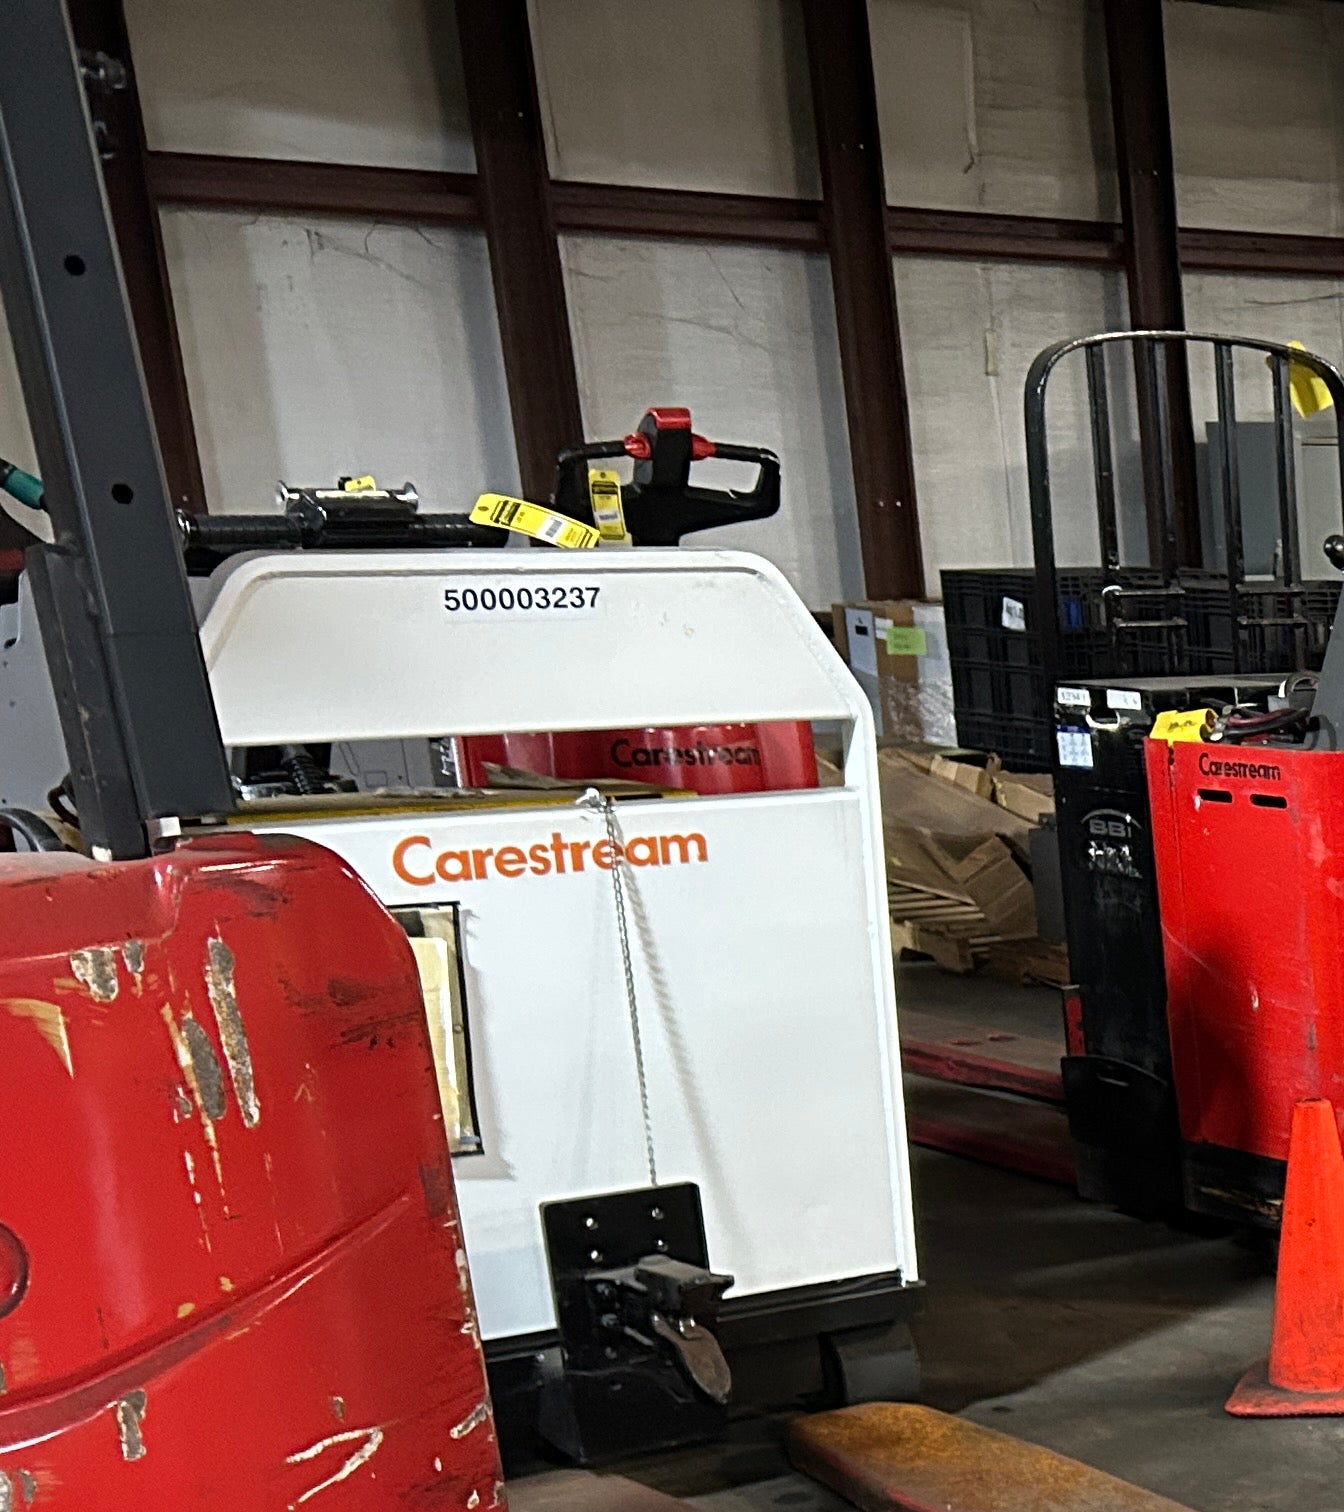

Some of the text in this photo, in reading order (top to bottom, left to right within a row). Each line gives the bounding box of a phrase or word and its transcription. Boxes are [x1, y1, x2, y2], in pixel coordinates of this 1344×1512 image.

[445, 587, 601, 611] 500003237
[1199, 752, 1281, 781] Carestream
[392, 832, 709, 887] Carestream
